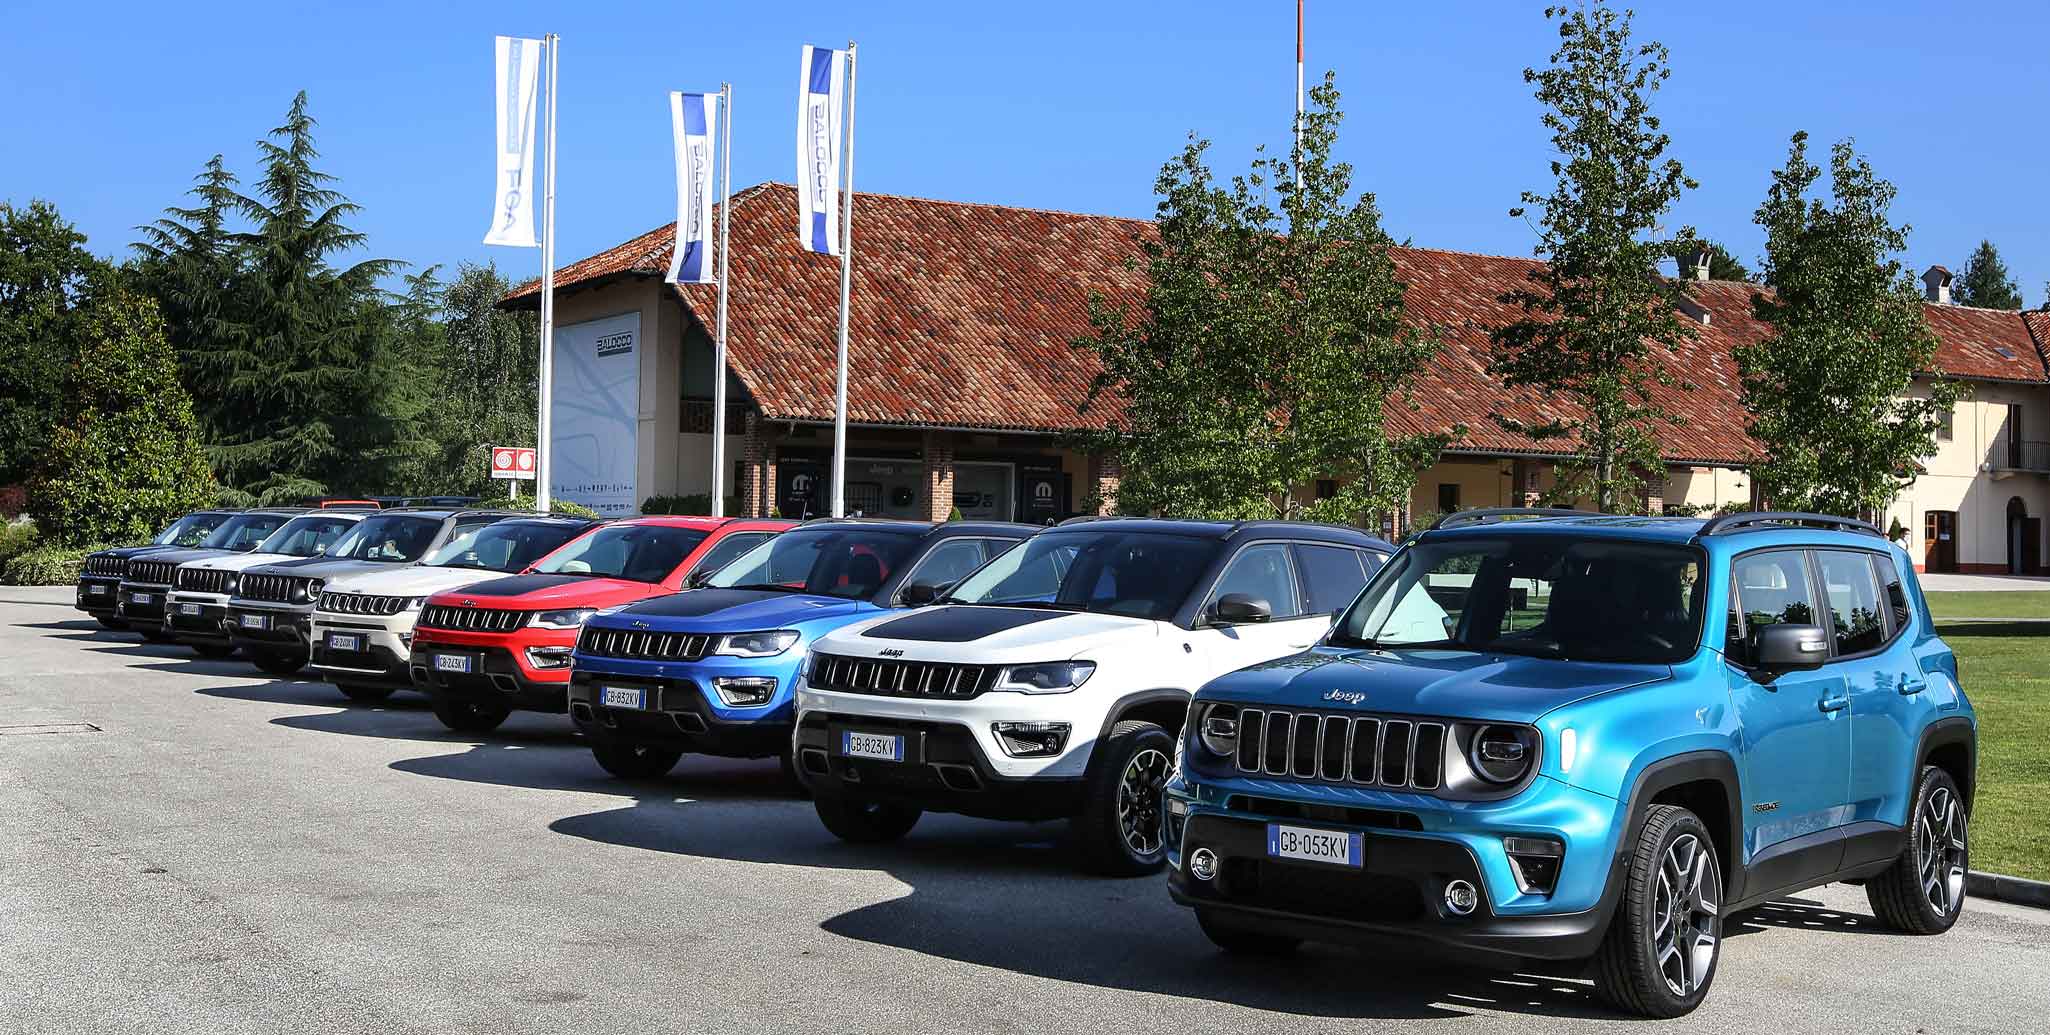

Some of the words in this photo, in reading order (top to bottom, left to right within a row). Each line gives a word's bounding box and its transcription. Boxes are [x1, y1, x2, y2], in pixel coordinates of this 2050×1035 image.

[597, 334, 632, 351] BALOCCO
[879, 647, 904, 658] Jeep
[1323, 688, 1365, 705] Jeep
